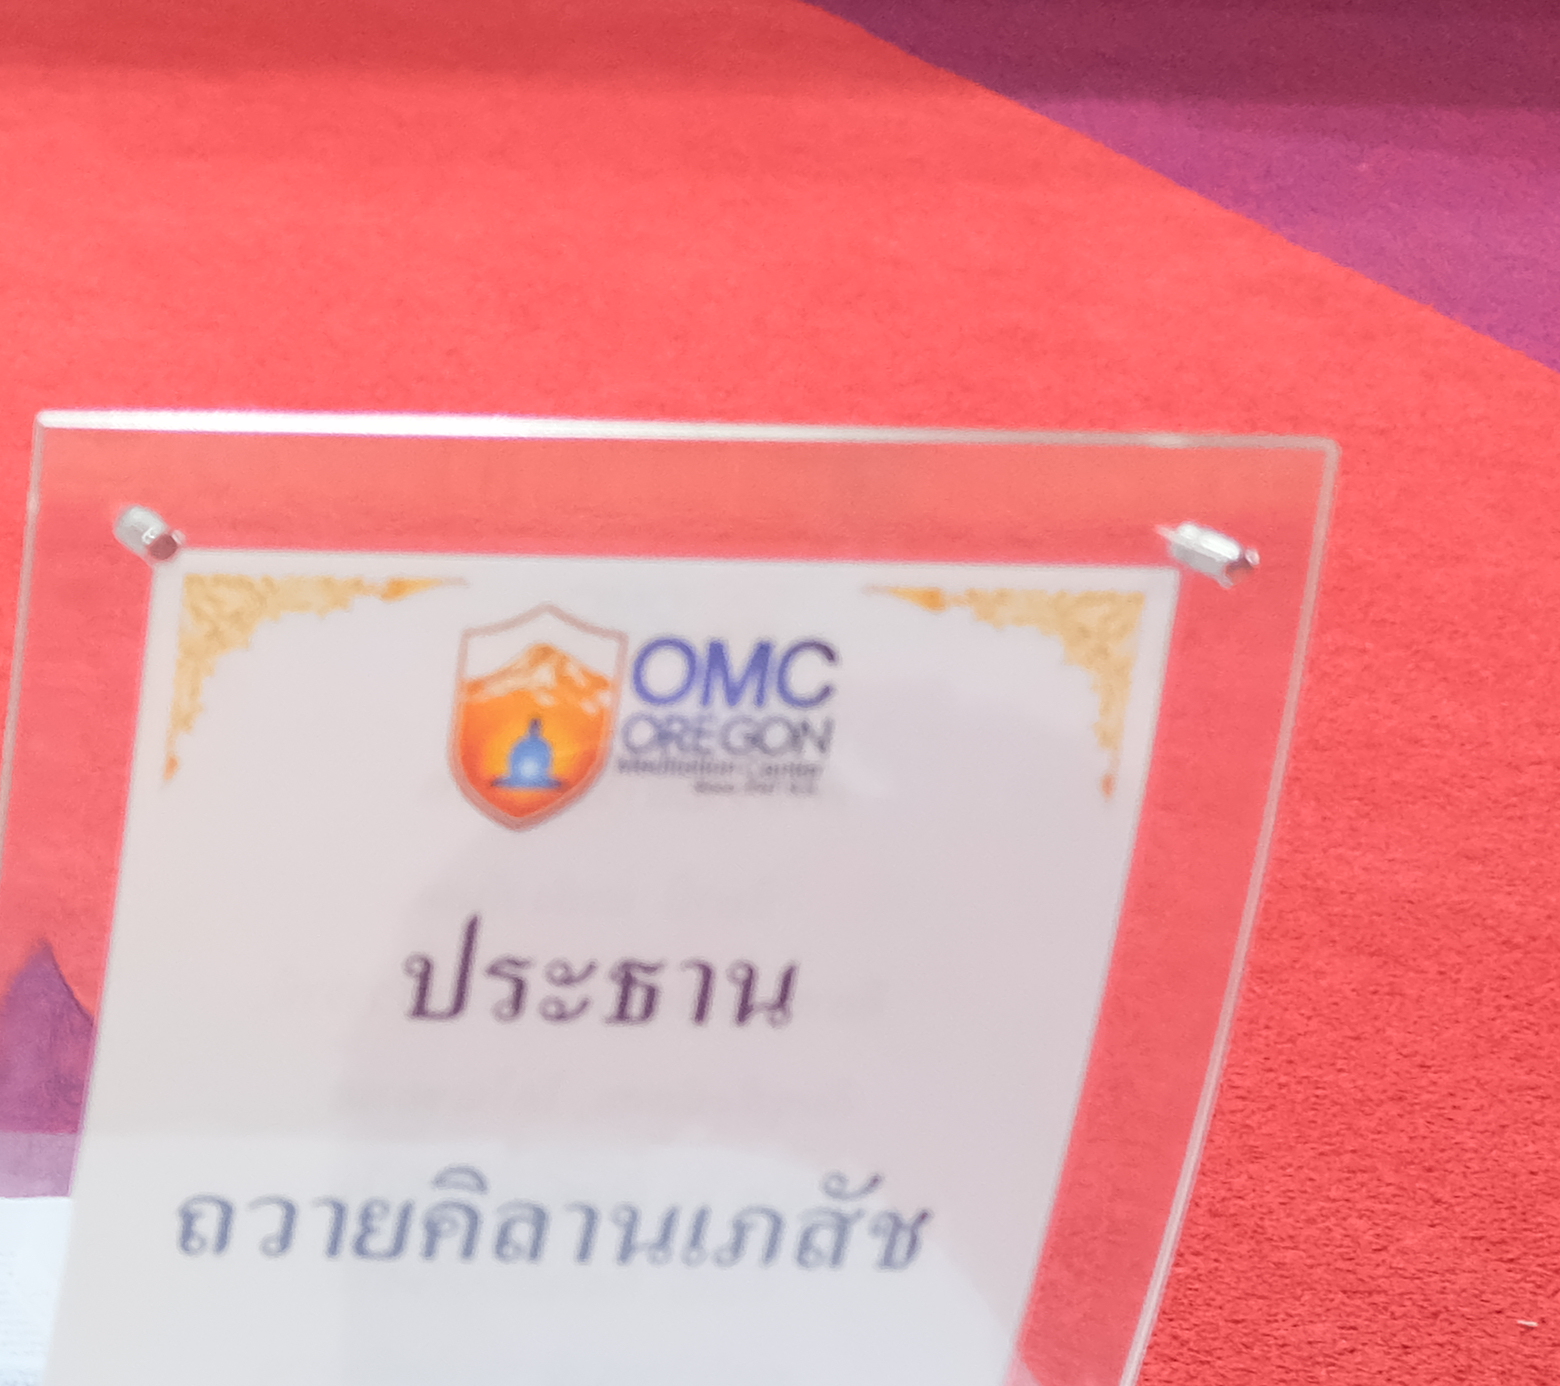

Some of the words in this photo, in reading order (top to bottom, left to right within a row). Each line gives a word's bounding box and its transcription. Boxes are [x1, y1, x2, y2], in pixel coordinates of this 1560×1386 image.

[631, 636, 838, 709] OMC
[622, 713, 835, 756] OREGON
[403, 911, 801, 1030] ประธาน
[173, 1163, 936, 1273] ถวายคิลานเภสัช
